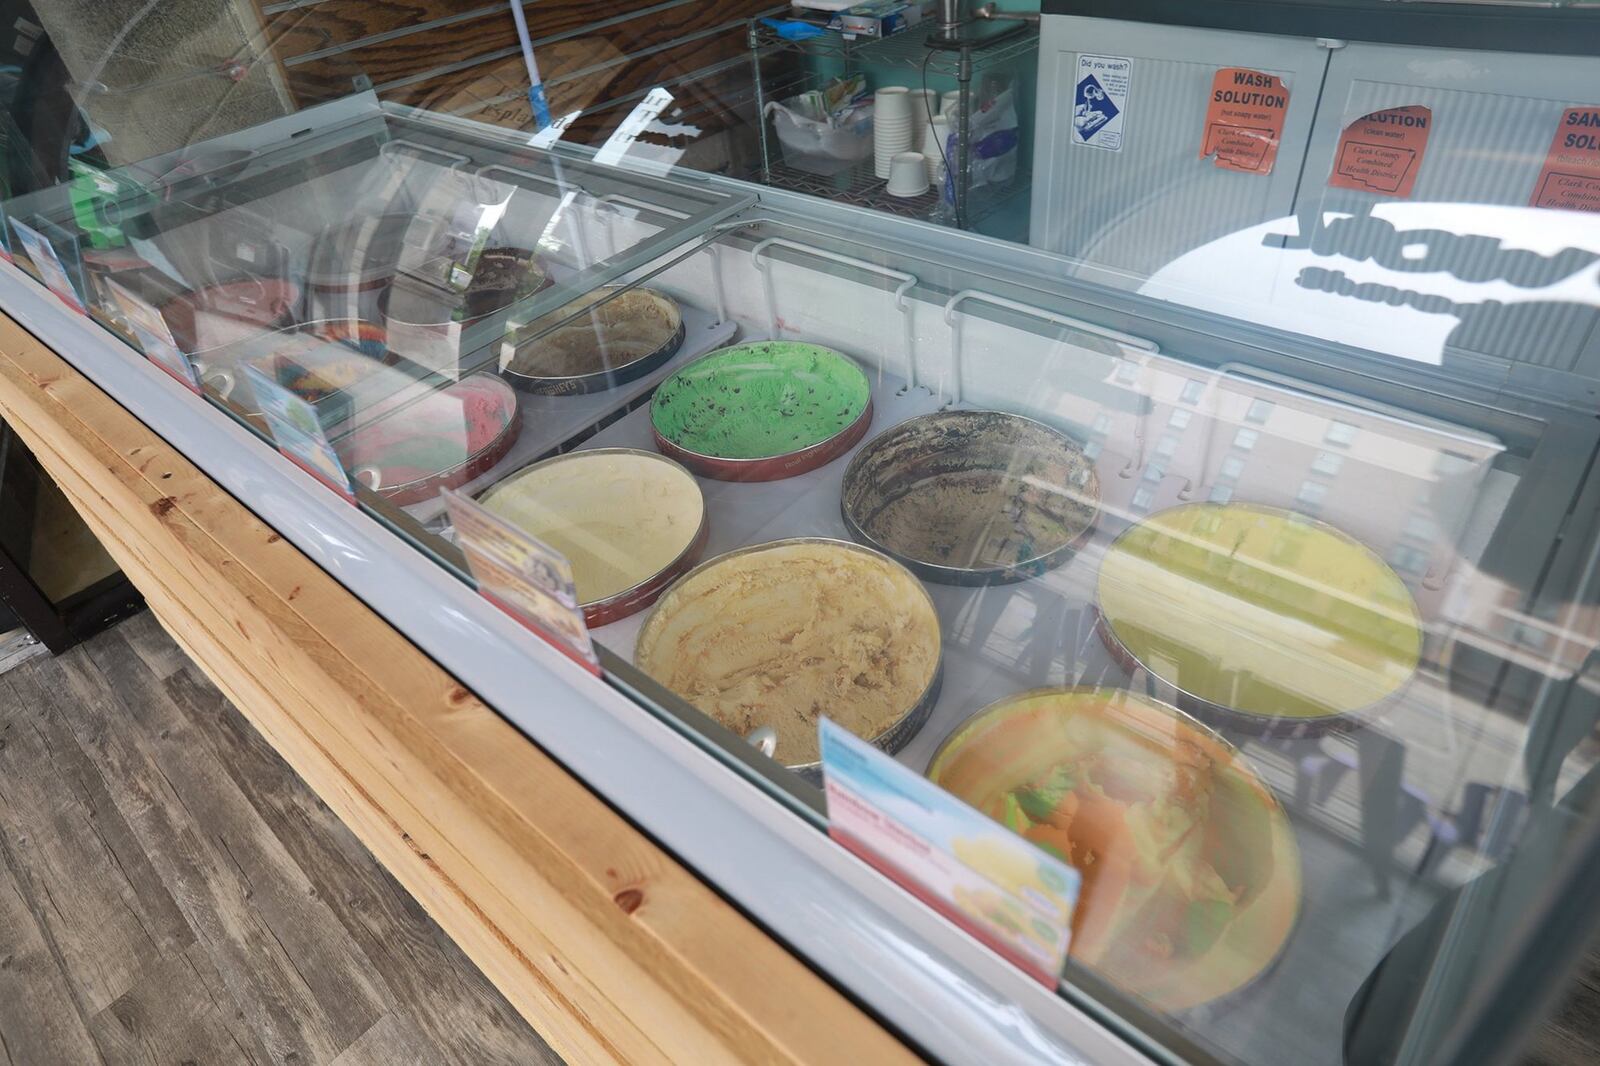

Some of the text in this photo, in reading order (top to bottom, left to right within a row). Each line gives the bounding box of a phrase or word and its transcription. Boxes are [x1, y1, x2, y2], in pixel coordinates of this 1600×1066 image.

[1234, 72, 1272, 88] WASH
[1214, 90, 1285, 108] SOLUTION
[1361, 113, 1426, 128] LUTION
[1356, 158, 1393, 168] Combined
[1558, 179, 1584, 188] Clark
